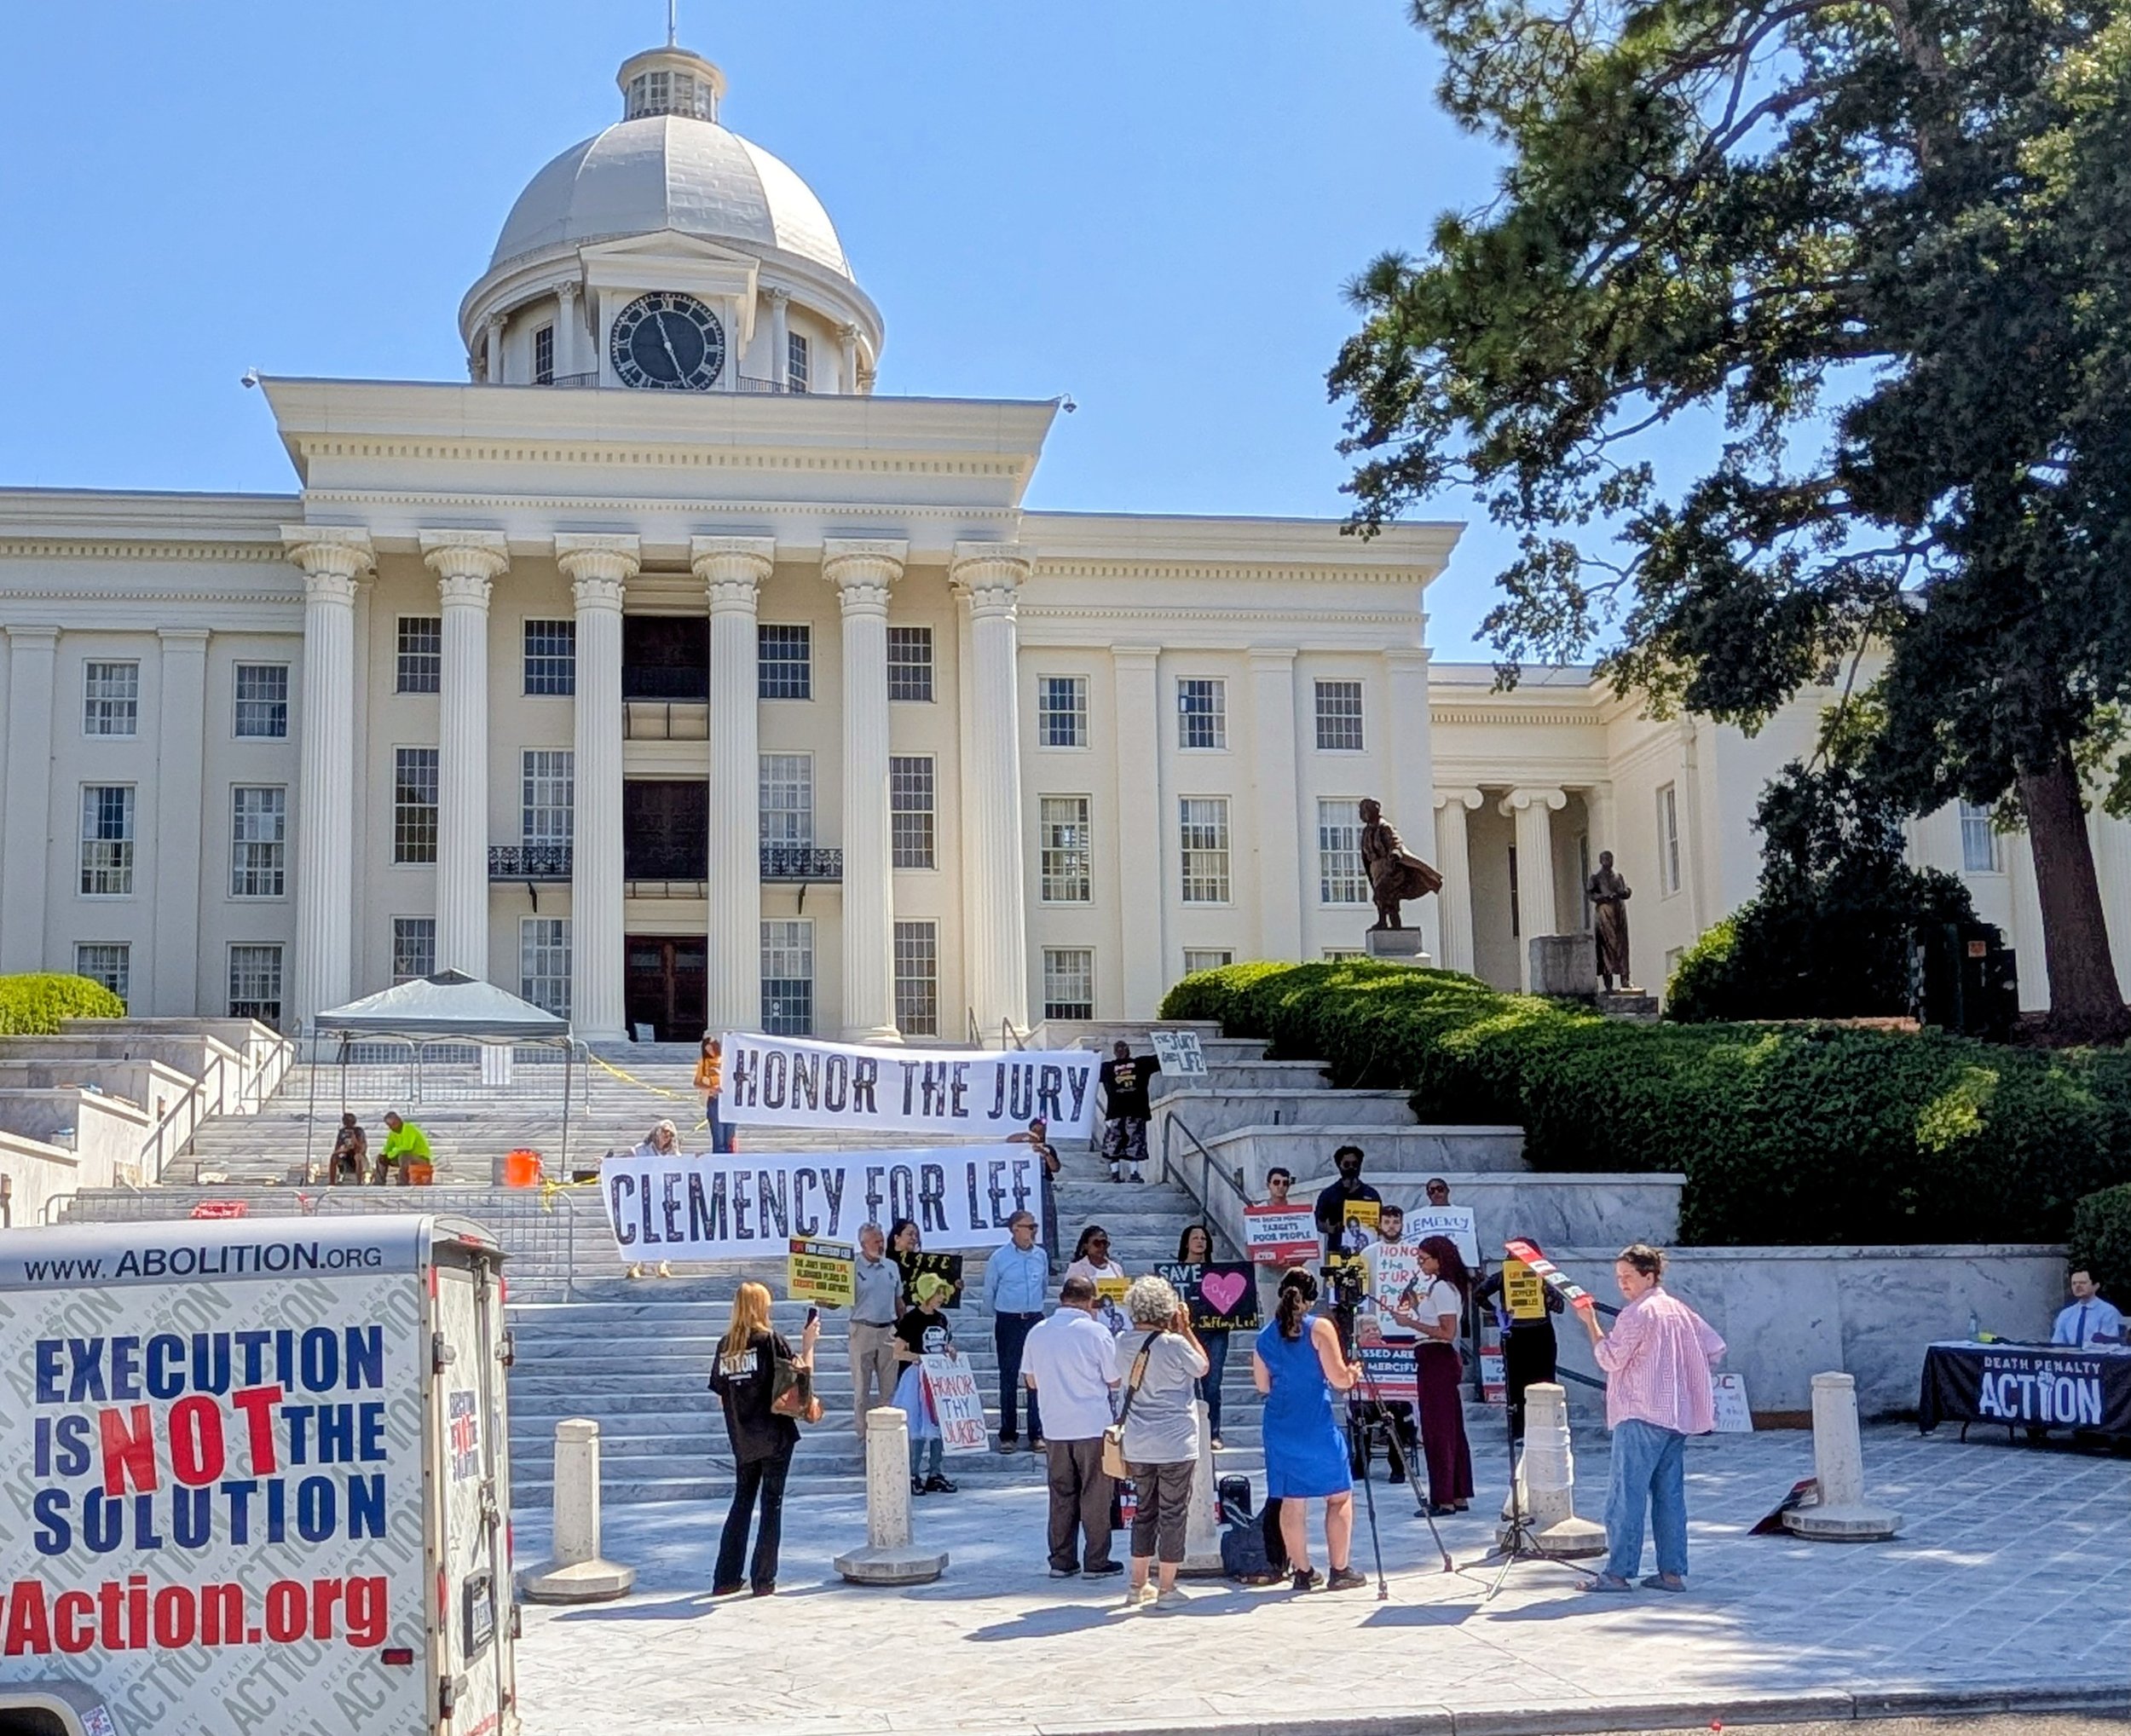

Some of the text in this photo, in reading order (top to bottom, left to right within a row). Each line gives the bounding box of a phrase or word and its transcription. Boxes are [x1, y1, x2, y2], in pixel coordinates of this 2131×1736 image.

[732, 1048, 879, 1114] HONOR
[898, 1058, 970, 1118] THE
[987, 1062, 1090, 1122] JURY
[609, 1158, 1032, 1245] CLEMENCY FOR LEE
[1158, 1263, 1203, 1283] SAVE
[35, 1325, 384, 1404] EXECUTION
[929, 1375, 976, 1398] HONOR
[1367, 1362, 1418, 1373] MERCIFU
[1984, 1355, 2101, 1375] DEATH PENALTY
[942, 1398, 970, 1419] THY
[1978, 1370, 2102, 1425] ACTION
[34, 1414, 91, 1477] IS
[98, 1386, 283, 1497] NOT
[281, 1402, 388, 1466] THE
[33, 1474, 387, 1555] SOLUTION
